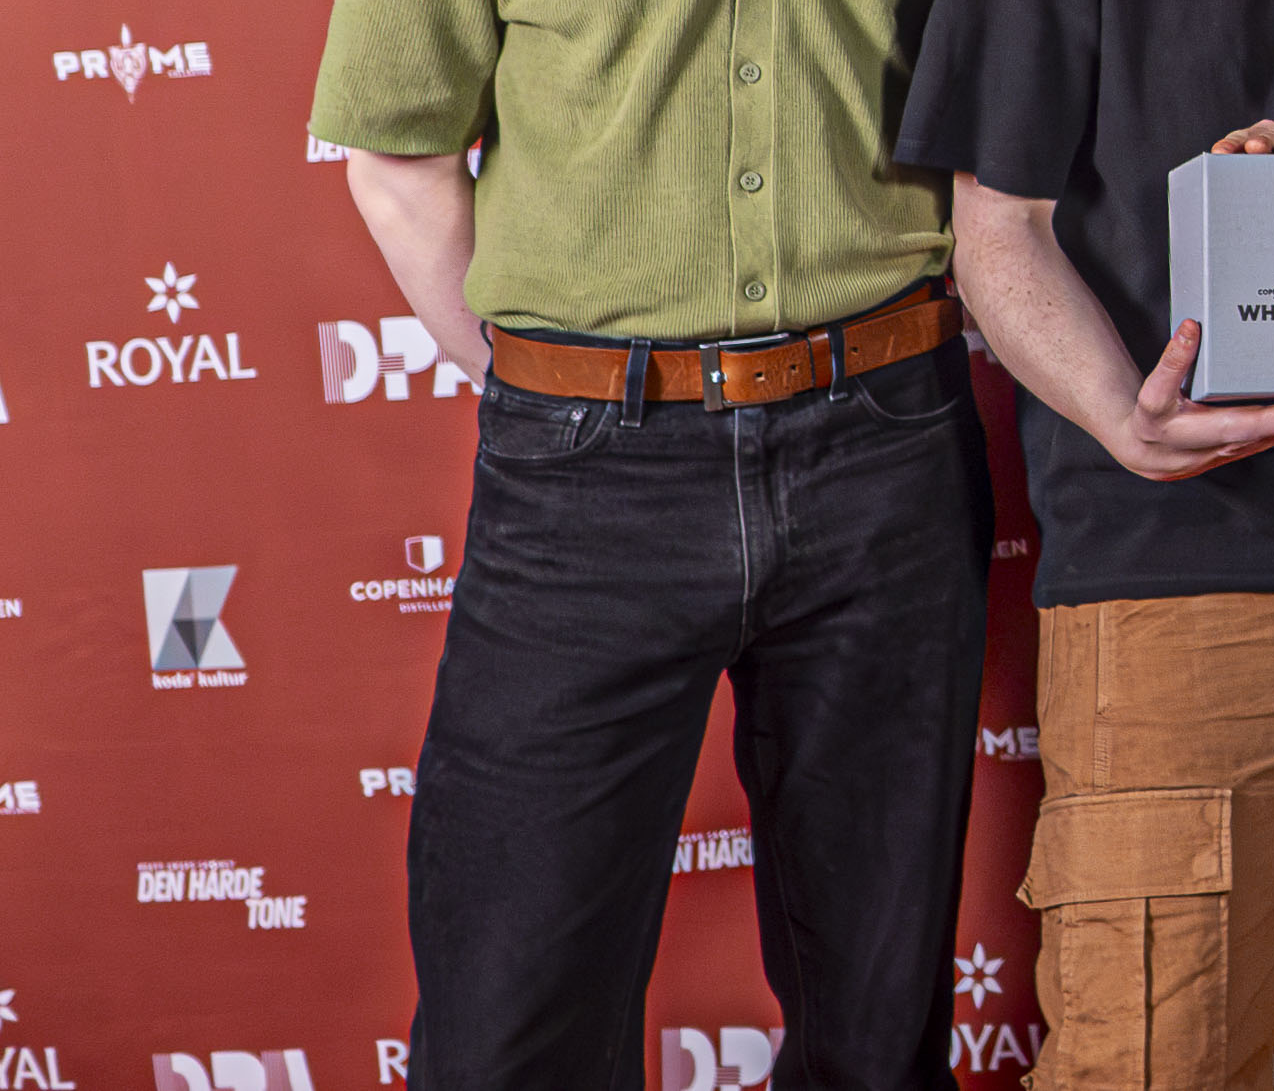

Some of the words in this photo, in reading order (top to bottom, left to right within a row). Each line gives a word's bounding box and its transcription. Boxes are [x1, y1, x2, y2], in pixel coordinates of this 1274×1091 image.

[86, 333, 256, 388] ROYAL
[137, 869, 185, 903] DEN
[245, 895, 307, 930] TONE
